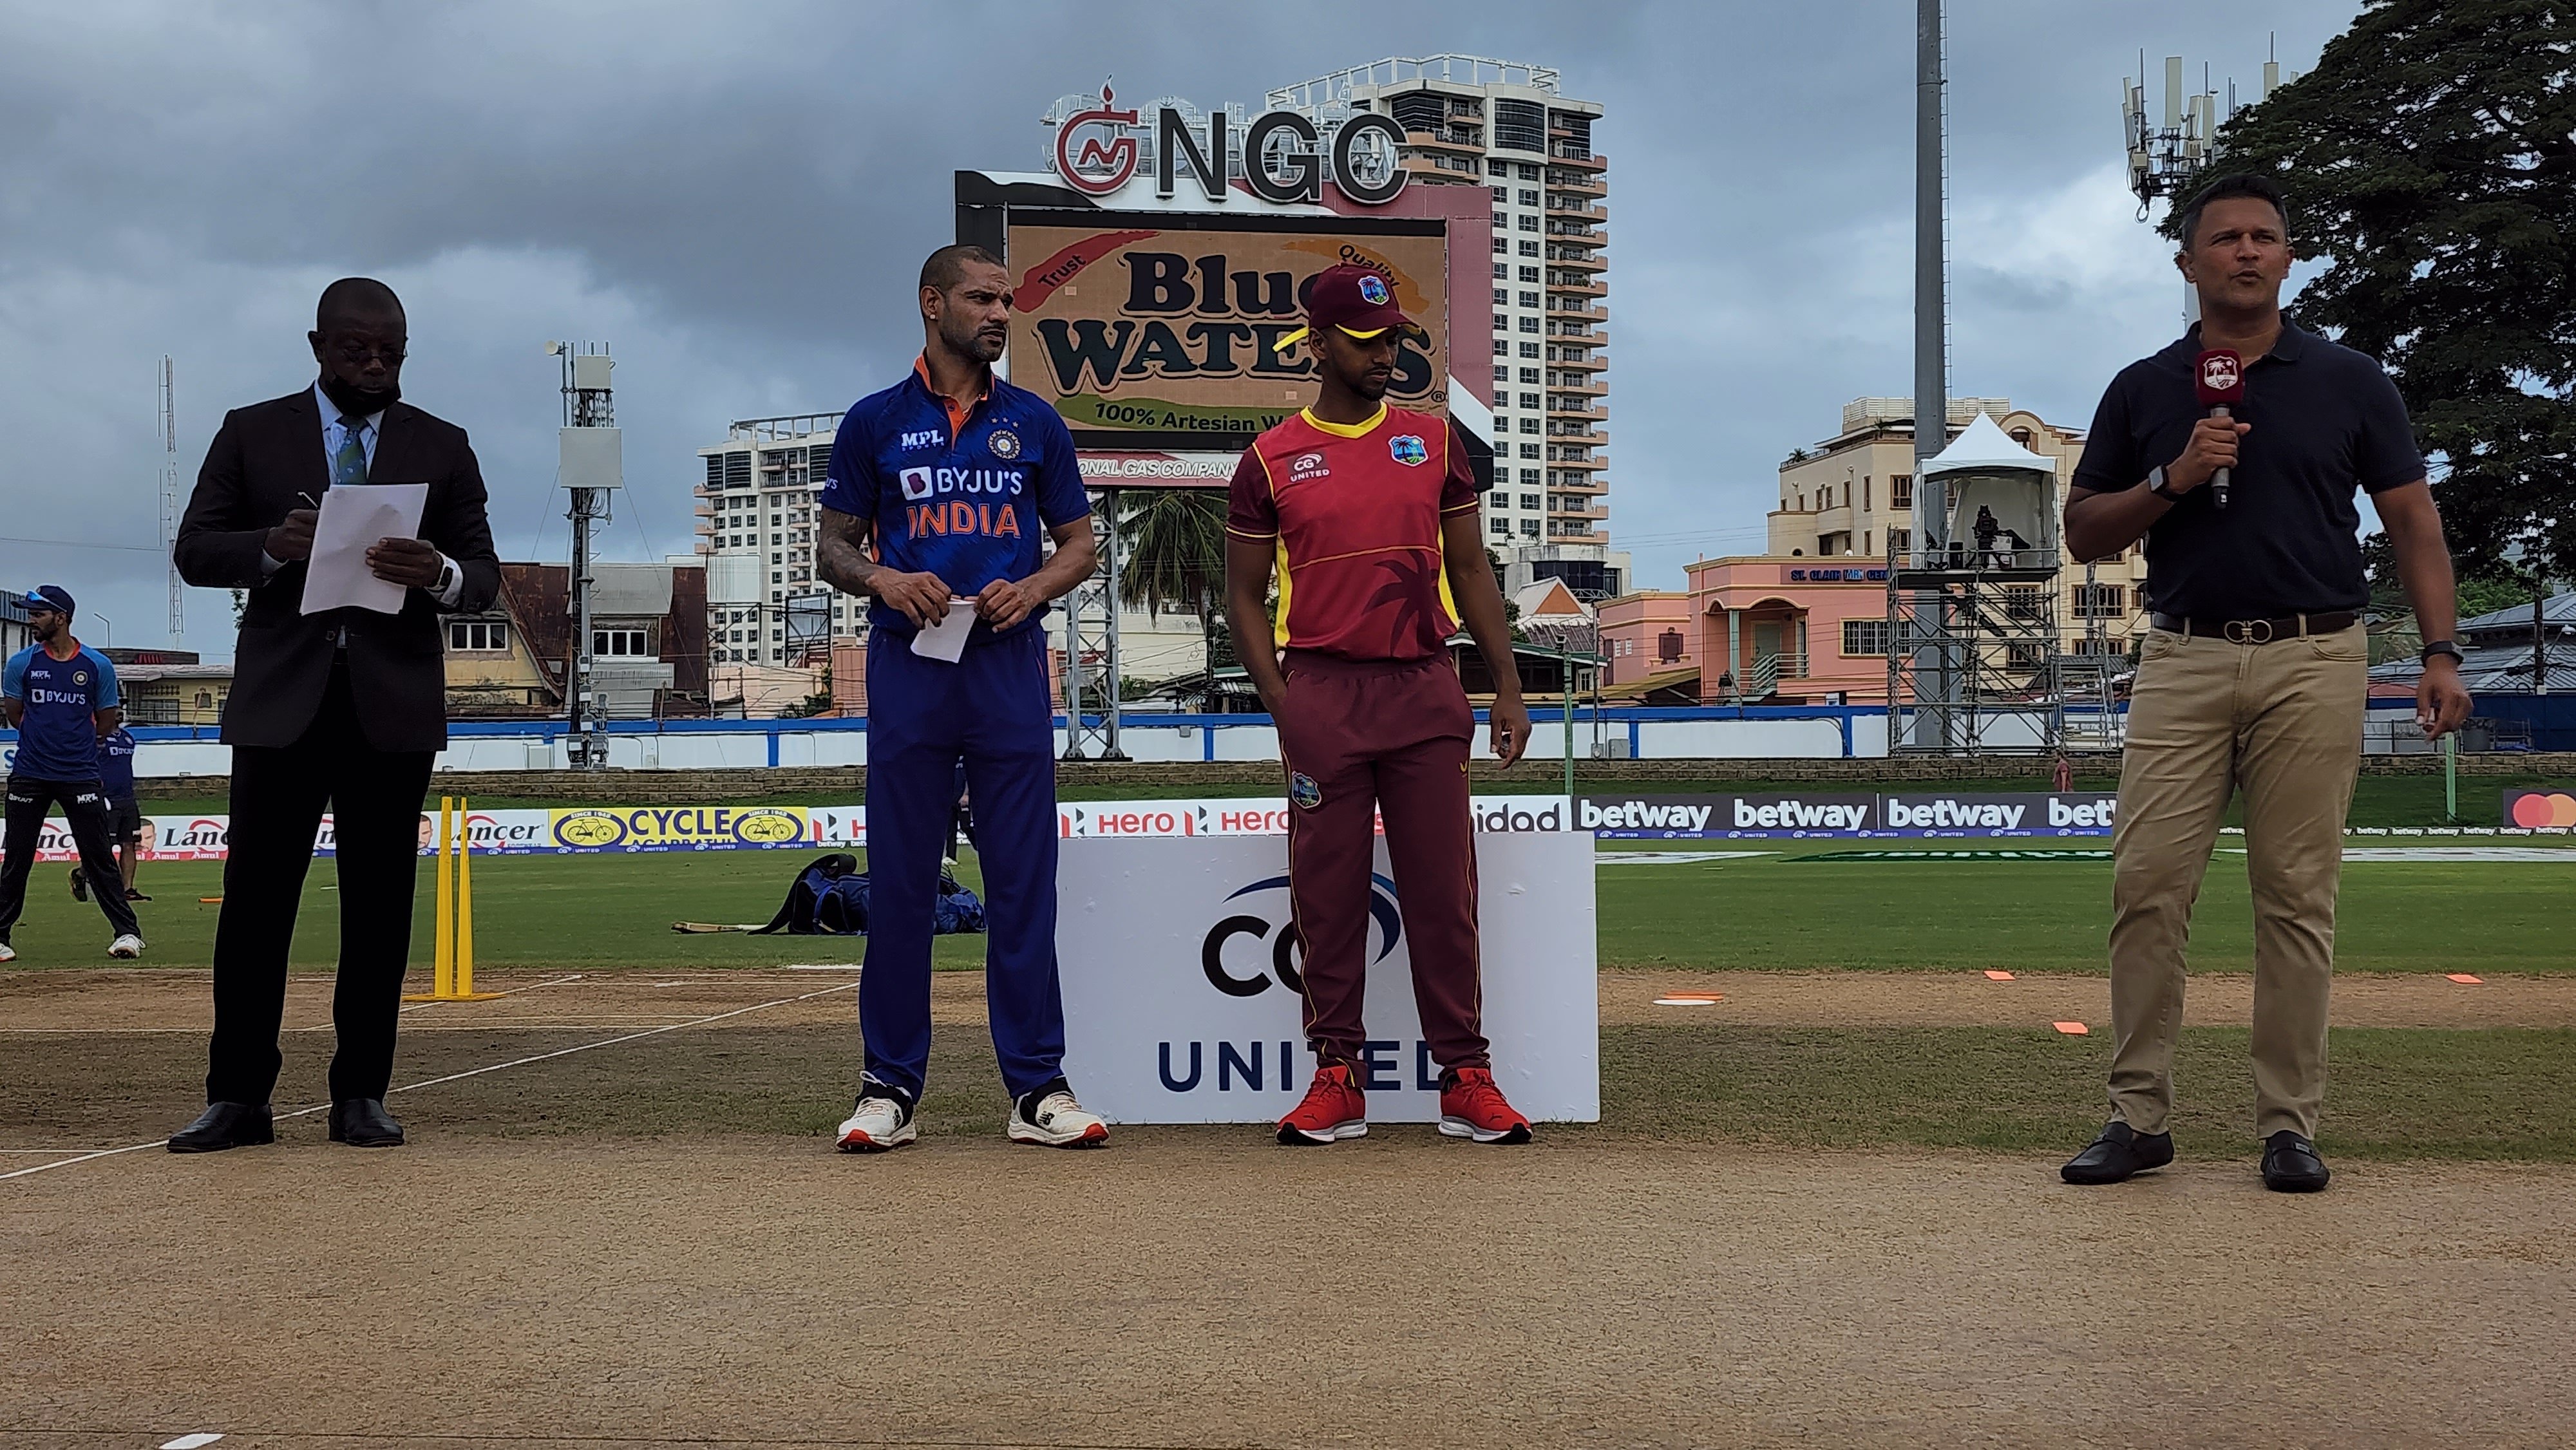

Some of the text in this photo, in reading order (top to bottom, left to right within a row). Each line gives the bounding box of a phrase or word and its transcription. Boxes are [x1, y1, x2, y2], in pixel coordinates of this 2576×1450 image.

[1158, 108, 1411, 205] NGC
[1037, 255, 1086, 287] Trust
[1123, 252, 1312, 314] Blu
[1037, 319, 1432, 394] WATES
[1095, 403, 1155, 426] 100%
[1161, 412, 1255, 431] Artesian
[902, 430, 943, 447] MPL
[1079, 460, 1238, 477] ONAL GAS COMPANY
[1290, 469, 1330, 482] UNITED
[1294, 458, 1314, 471] CG
[937, 467, 1023, 494] BYJU'S
[907, 500, 1021, 540] INDIA
[1867, 570, 1888, 579] CEN
[46, 691, 86, 704] BYJU'S
[629, 809, 730, 836] CYCLE
[1099, 813, 1175, 833] Hero
[1476, 802, 1560, 832] idad
[1580, 799, 1712, 832] betway
[1734, 798, 1868, 831] betway
[1888, 799, 2025, 830] betway
[451, 825, 541, 841] ancer
[153, 851, 180, 860] Amul
[193, 851, 220, 860] Amul
[1159, 1040, 1444, 1093] UNIE
